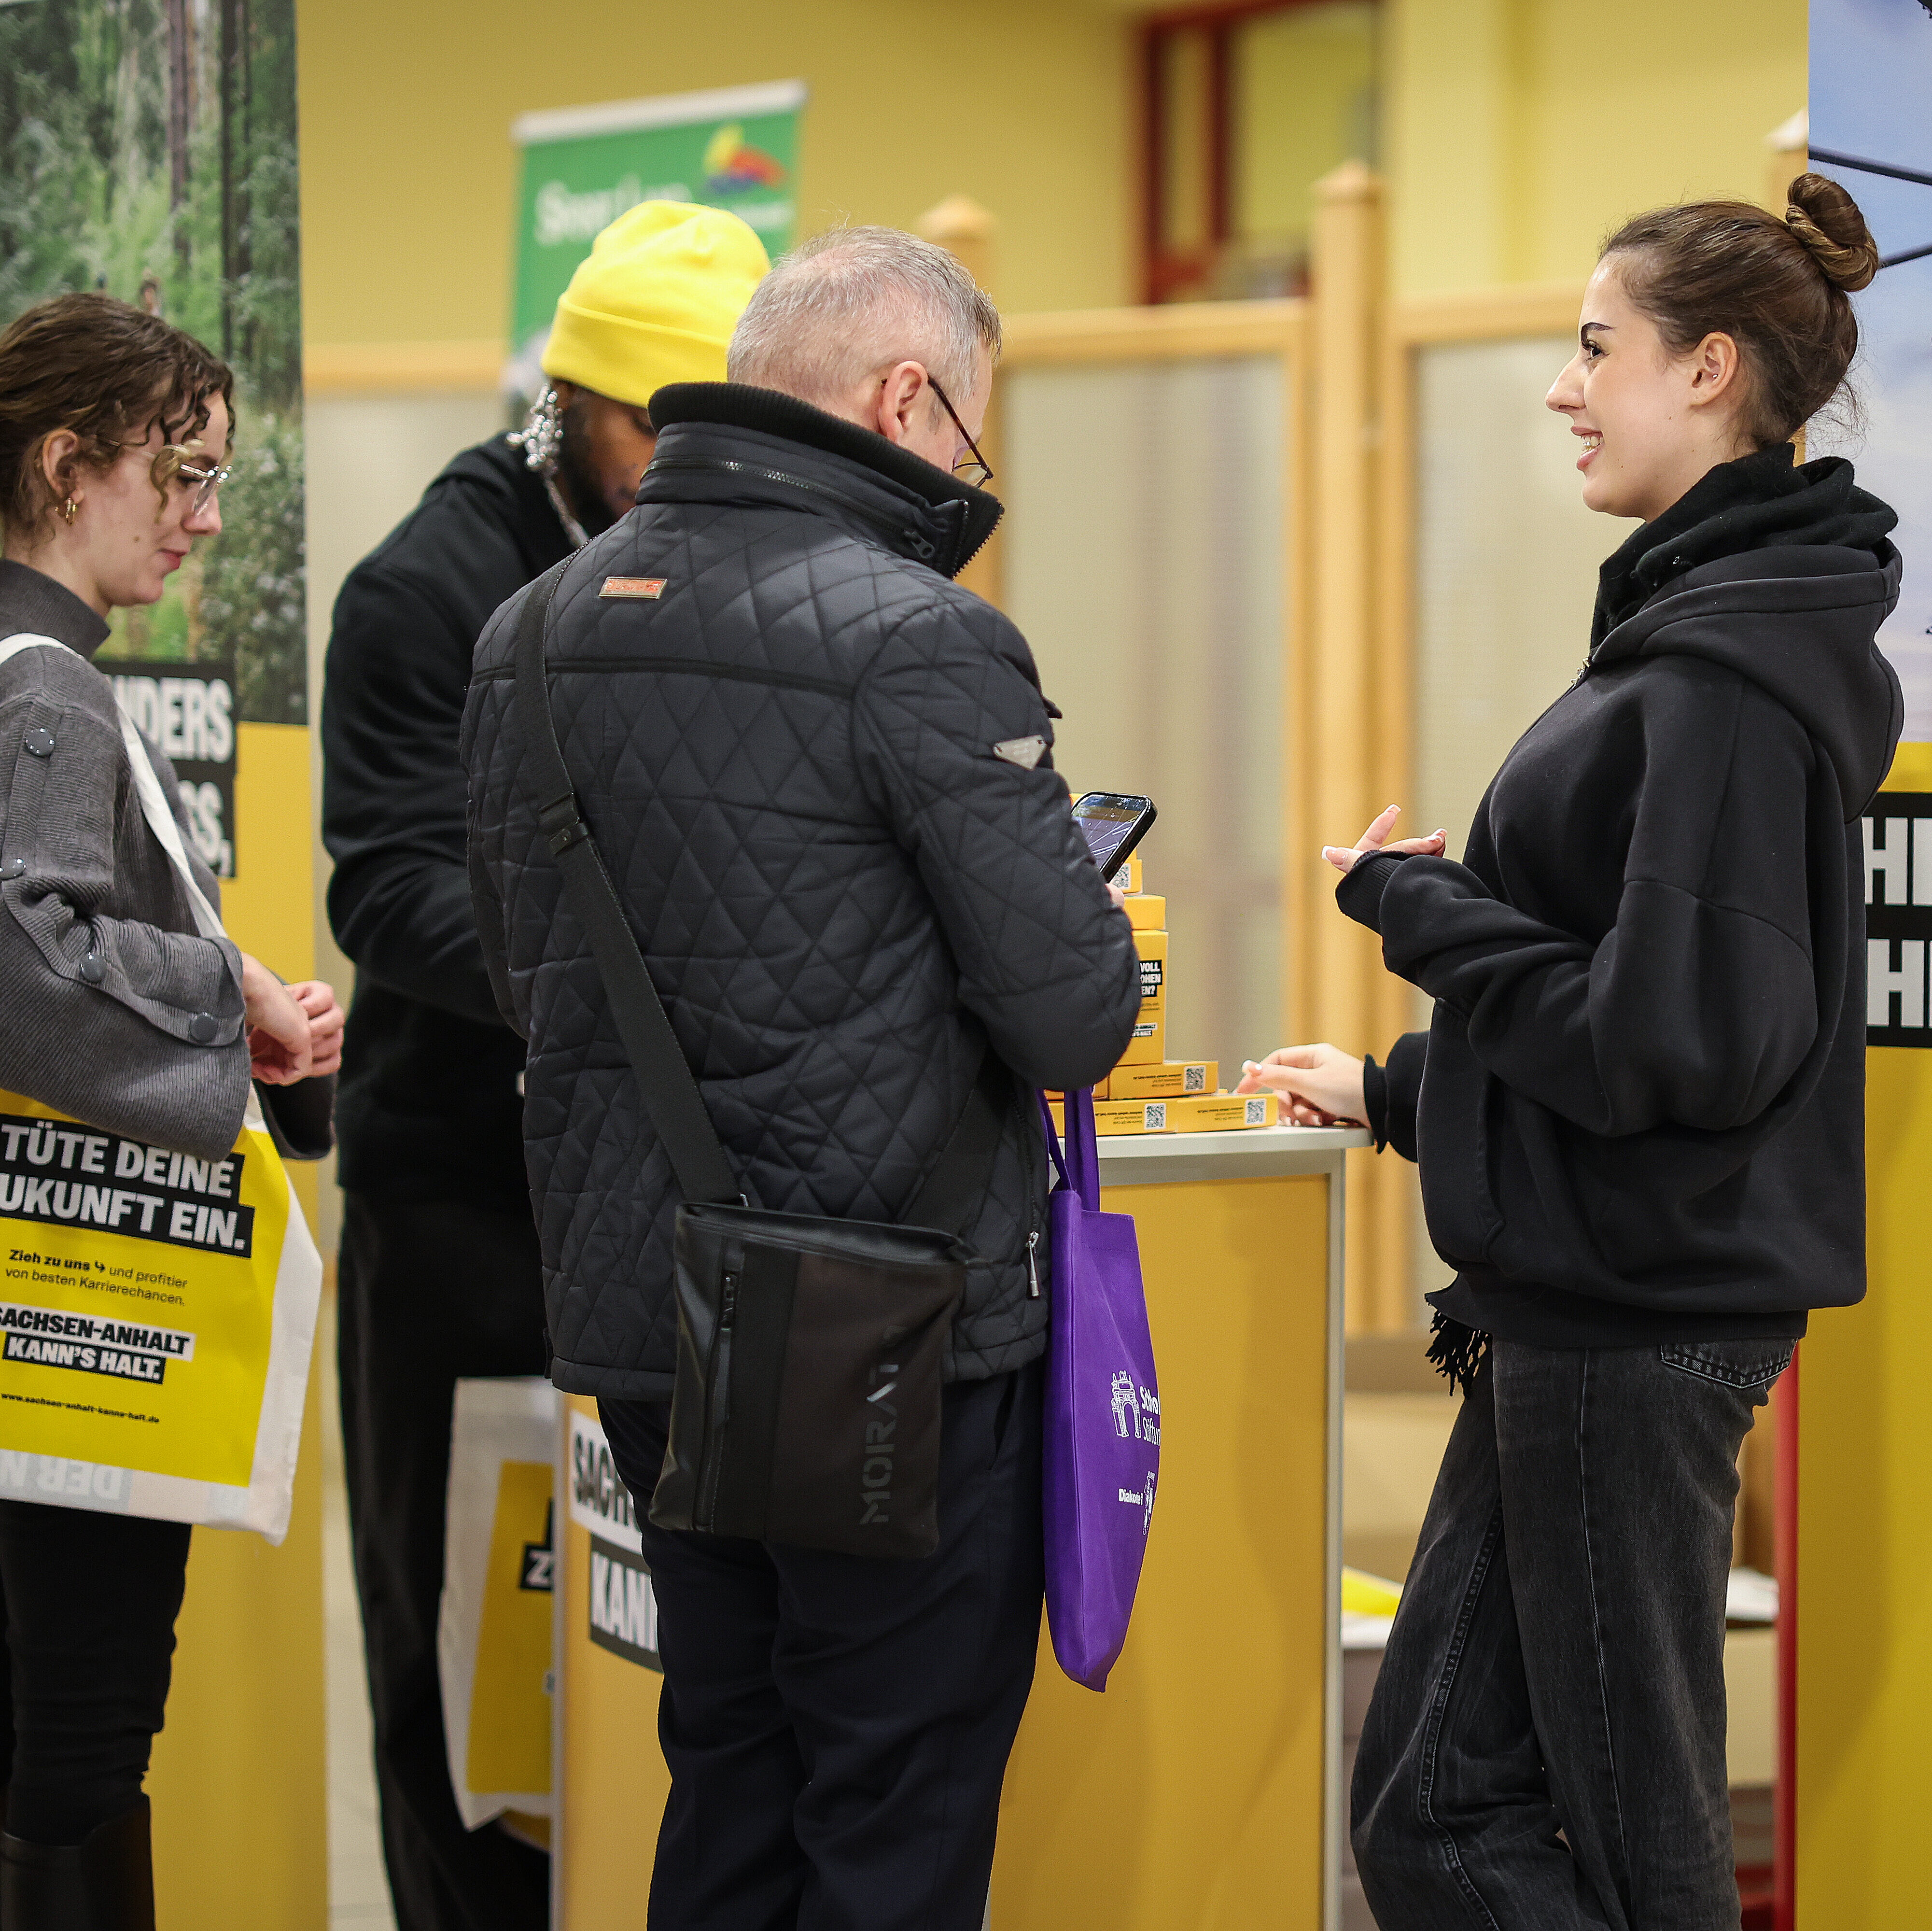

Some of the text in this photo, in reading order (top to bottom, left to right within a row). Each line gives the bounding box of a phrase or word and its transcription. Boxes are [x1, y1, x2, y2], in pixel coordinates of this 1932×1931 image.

[1140, 962, 1160, 973] VOLL
[1, 1121, 235, 1198] TÜTE DEINE
[169, 1201, 246, 1250] EIN.
[6, 1268, 28, 1280] von
[32, 1269, 76, 1286] besten
[9, 1249, 188, 1289] Zieh zu uns und profitier
[0, 1307, 190, 1354] ACHSEN-ANHALT
[7, 1336, 160, 1380] KANN'S HALT.
